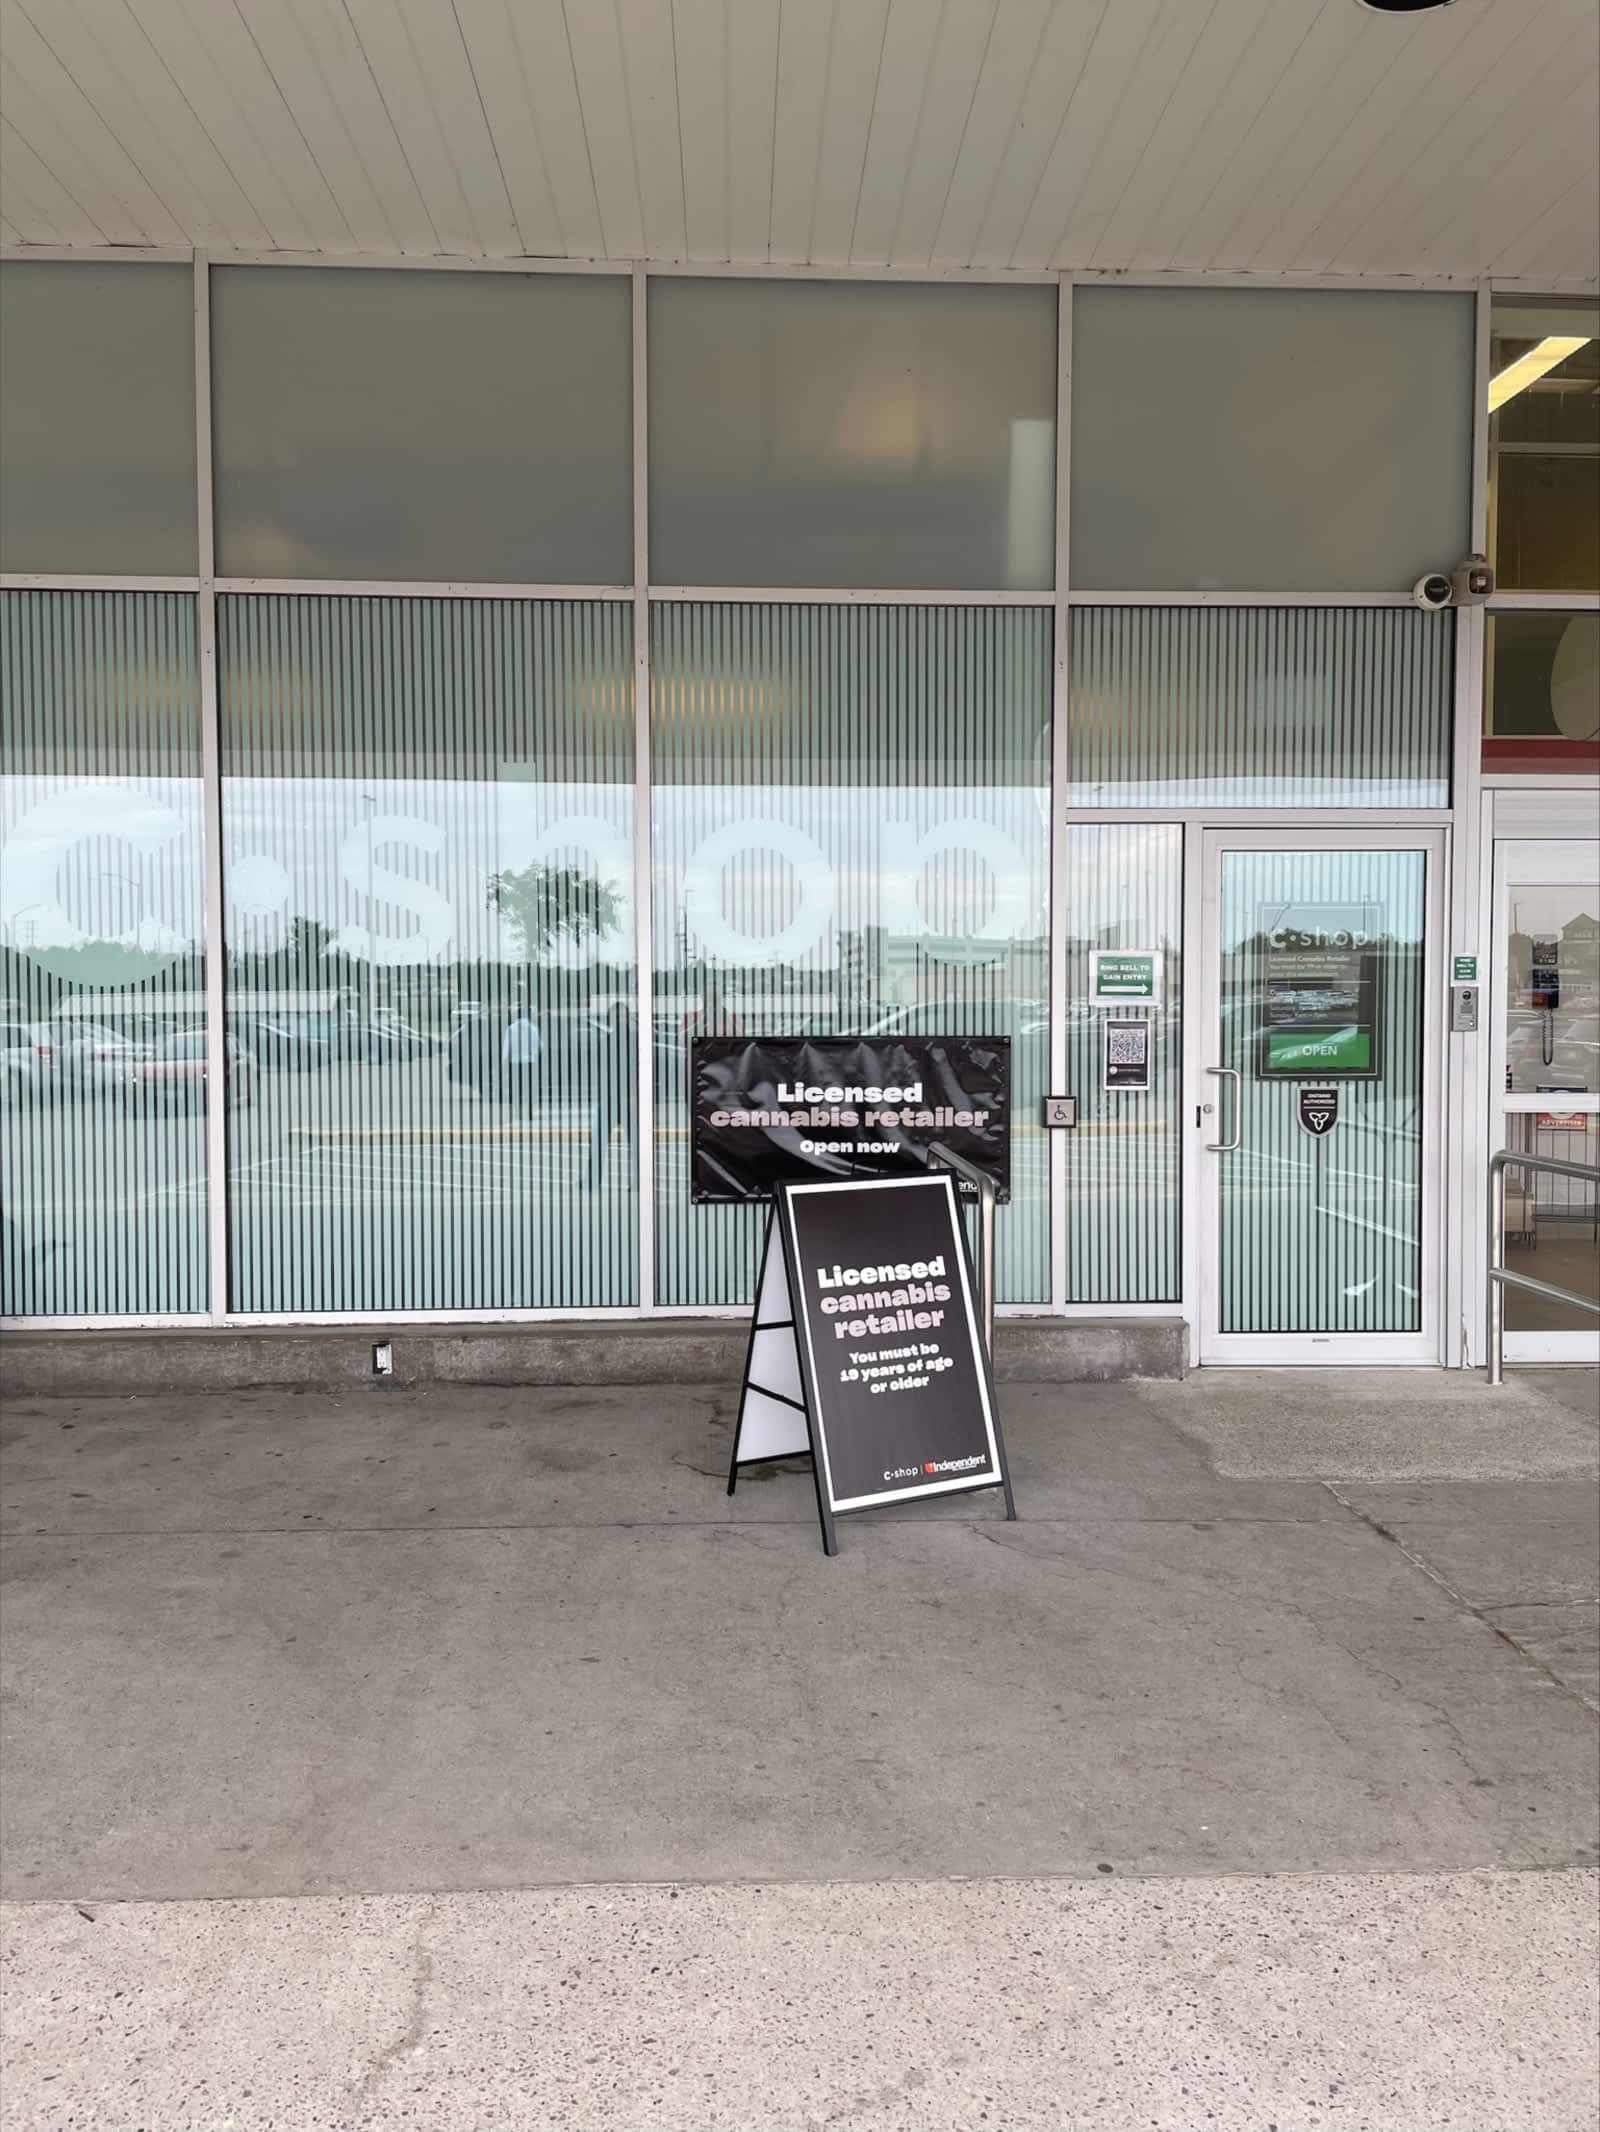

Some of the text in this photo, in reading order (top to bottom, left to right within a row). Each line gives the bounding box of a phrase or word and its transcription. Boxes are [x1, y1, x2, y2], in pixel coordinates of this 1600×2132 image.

[1302, 1045, 1337, 1056] OPEN
[777, 1082, 922, 1103] Licensed
[710, 1107, 989, 1127] cannabis retailer
[800, 1140, 900, 1155] Open now
[817, 1255, 946, 1289] Licensed
[820, 1281, 951, 1314] cannabis
[834, 1309, 944, 1339] retailer
[850, 1343, 940, 1364] You must be
[840, 1357, 953, 1382] 19 years of age
[870, 1376, 929, 1393] or older
[933, 1454, 986, 1473] Independent
